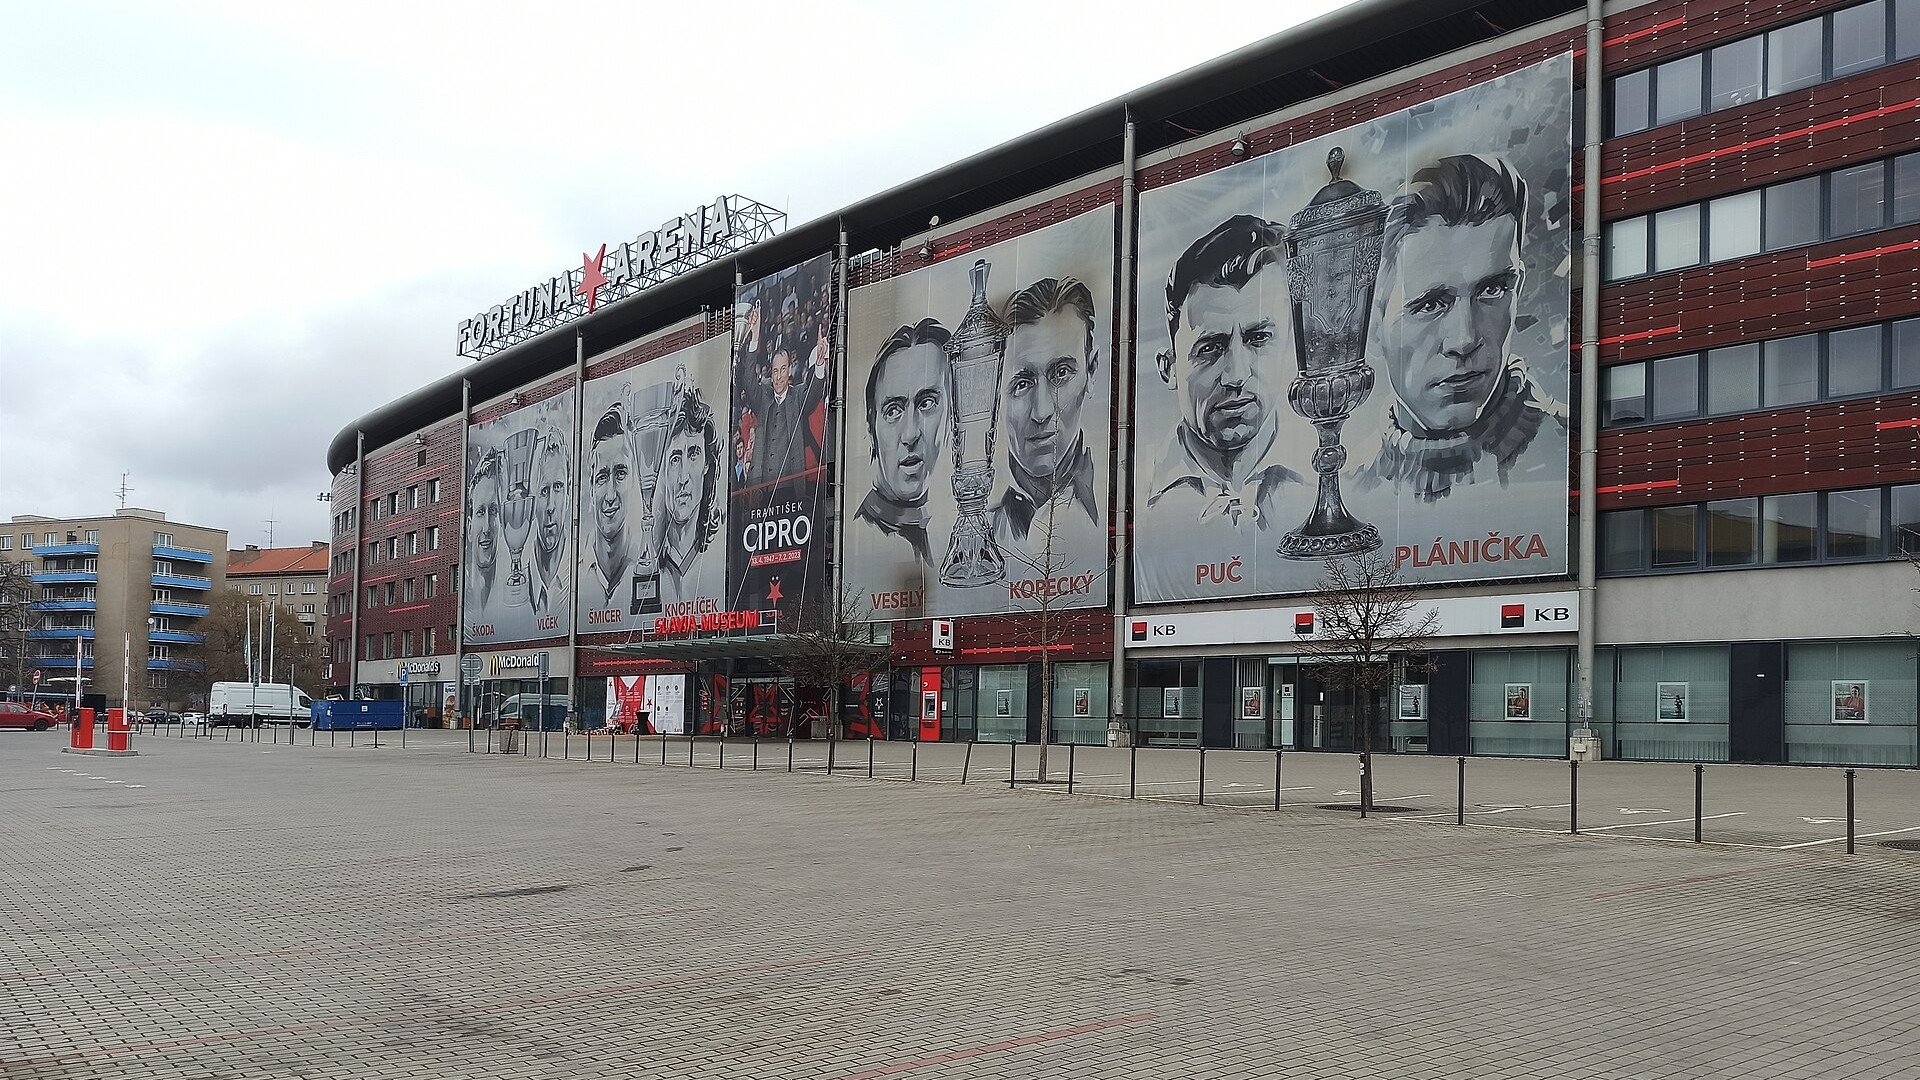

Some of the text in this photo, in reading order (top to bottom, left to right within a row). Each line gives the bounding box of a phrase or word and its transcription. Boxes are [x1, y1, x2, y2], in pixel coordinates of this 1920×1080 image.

[456, 195, 734, 357] FORTUNA ARENA
[751, 501, 803, 519] FRANTIŠEK
[743, 515, 811, 552] CIPRO
[1395, 531, 1549, 568] PLÁNIČKA
[1196, 555, 1243, 585] PUČ
[1009, 569, 1094, 600] KOPECKÝ
[664, 596, 719, 617] KNOFLÍČEK
[871, 585, 924, 610] VESELÝ
[537, 615, 559, 631] VLČEK
[588, 608, 621, 625] ŠMICER
[654, 609, 759, 635] SLAVIA MUSEUM
[1535, 607, 1570, 622] KB
[472, 623, 495, 637] ŠKODA
[1153, 625, 1176, 636] KB
[938, 638, 951, 647] KB
[499, 653, 539, 669] McDonald
